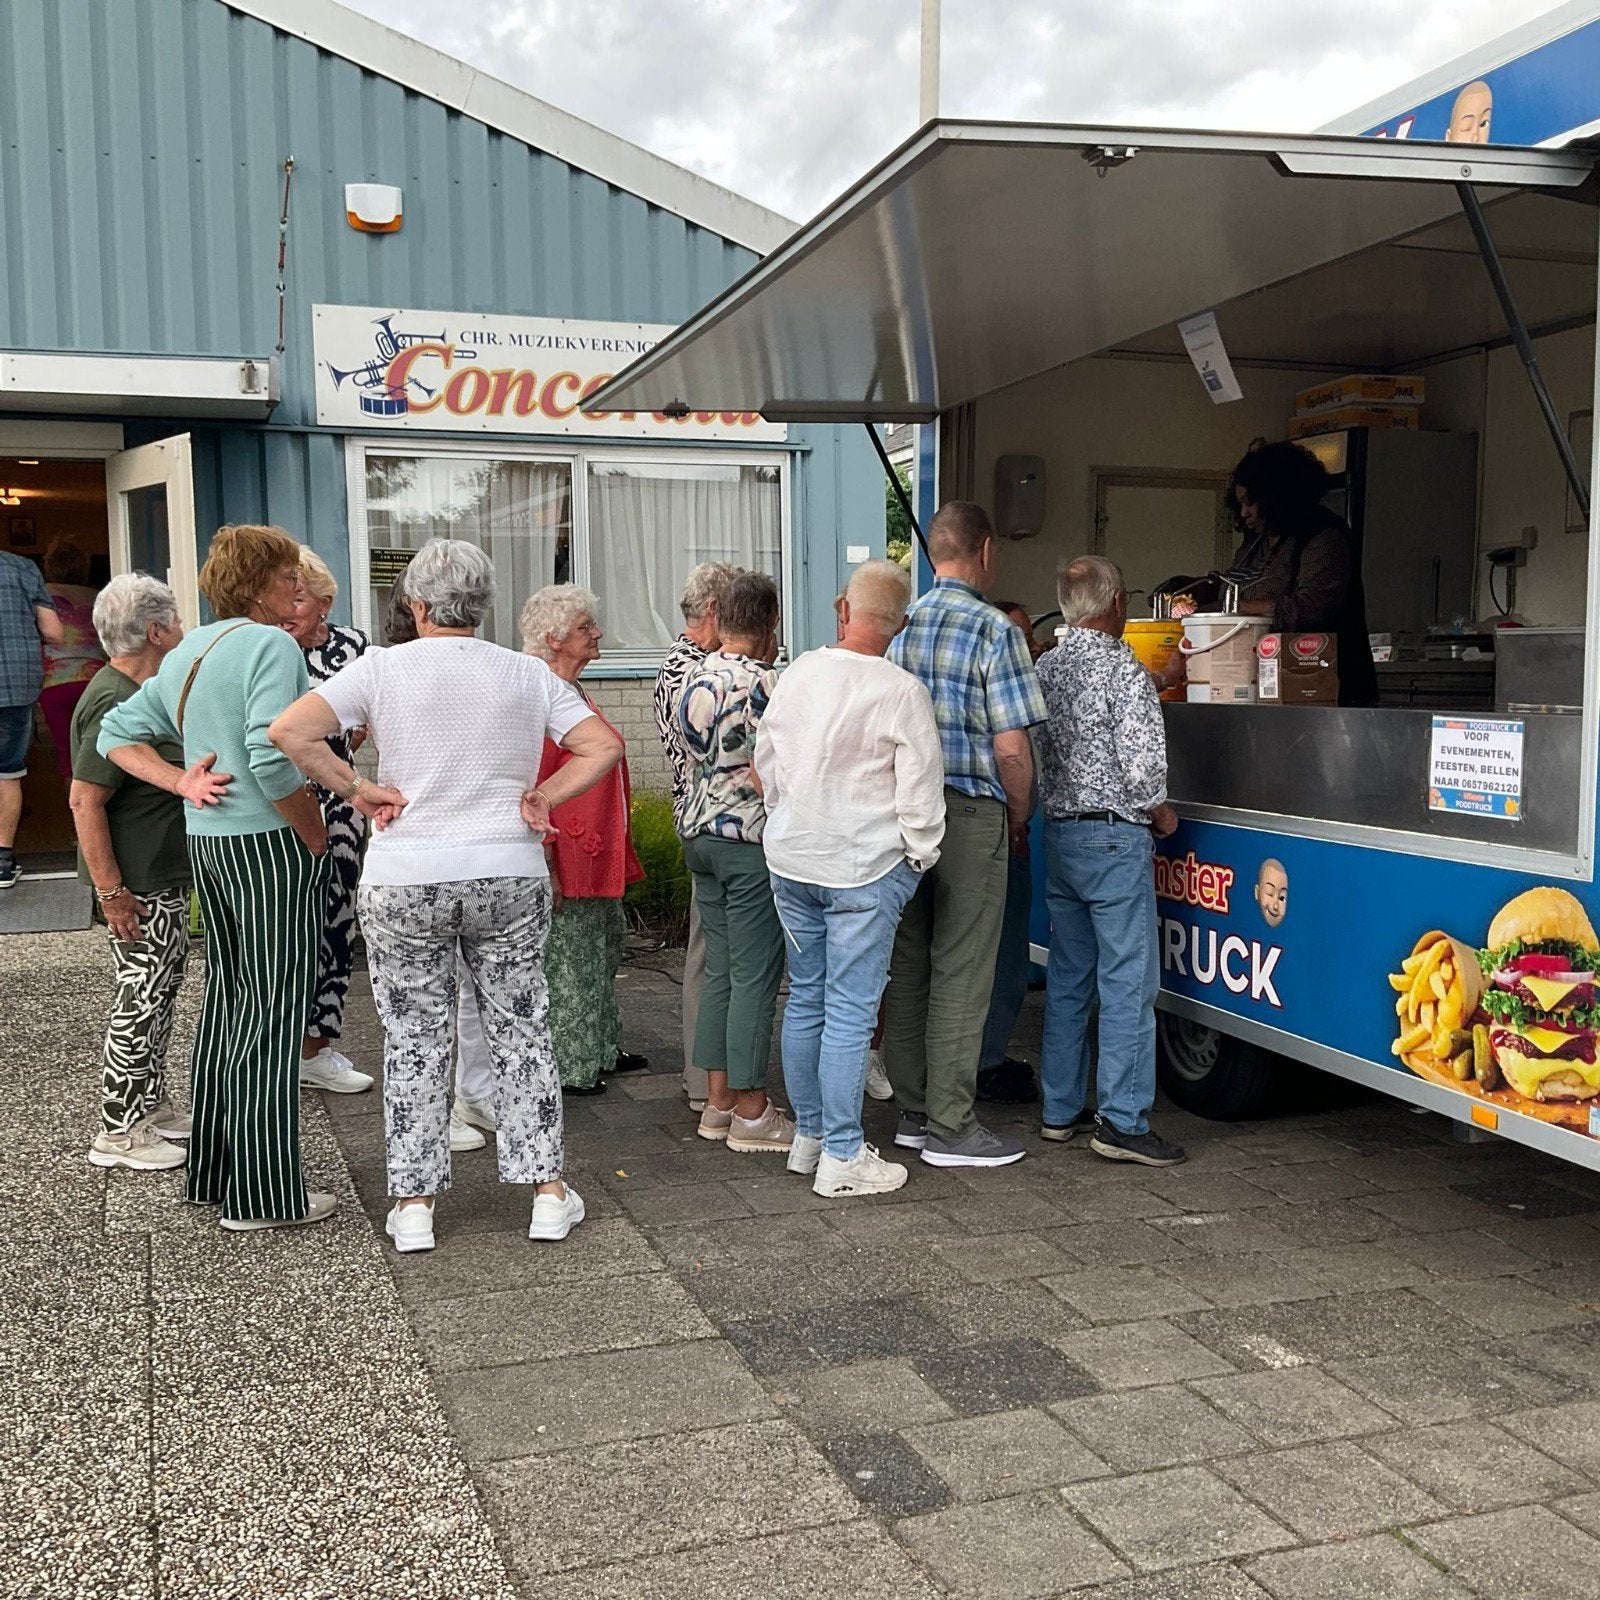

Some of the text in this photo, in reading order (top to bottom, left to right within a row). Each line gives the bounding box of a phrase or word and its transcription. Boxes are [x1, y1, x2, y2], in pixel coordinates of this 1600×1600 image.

[460, 330, 659, 353] CHR. MUZIEKVERENI
[384, 343, 762, 427] Conco
[1299, 640, 1318, 650] KERN
[1463, 731, 1490, 742] VOOR
[1440, 745, 1514, 761] EVENEMENTEN,
[1434, 760, 1519, 777] FEESTEN, BELLEN
[1434, 776, 1519, 794] NAAR 0657962120
[1153, 850, 1235, 915] nster
